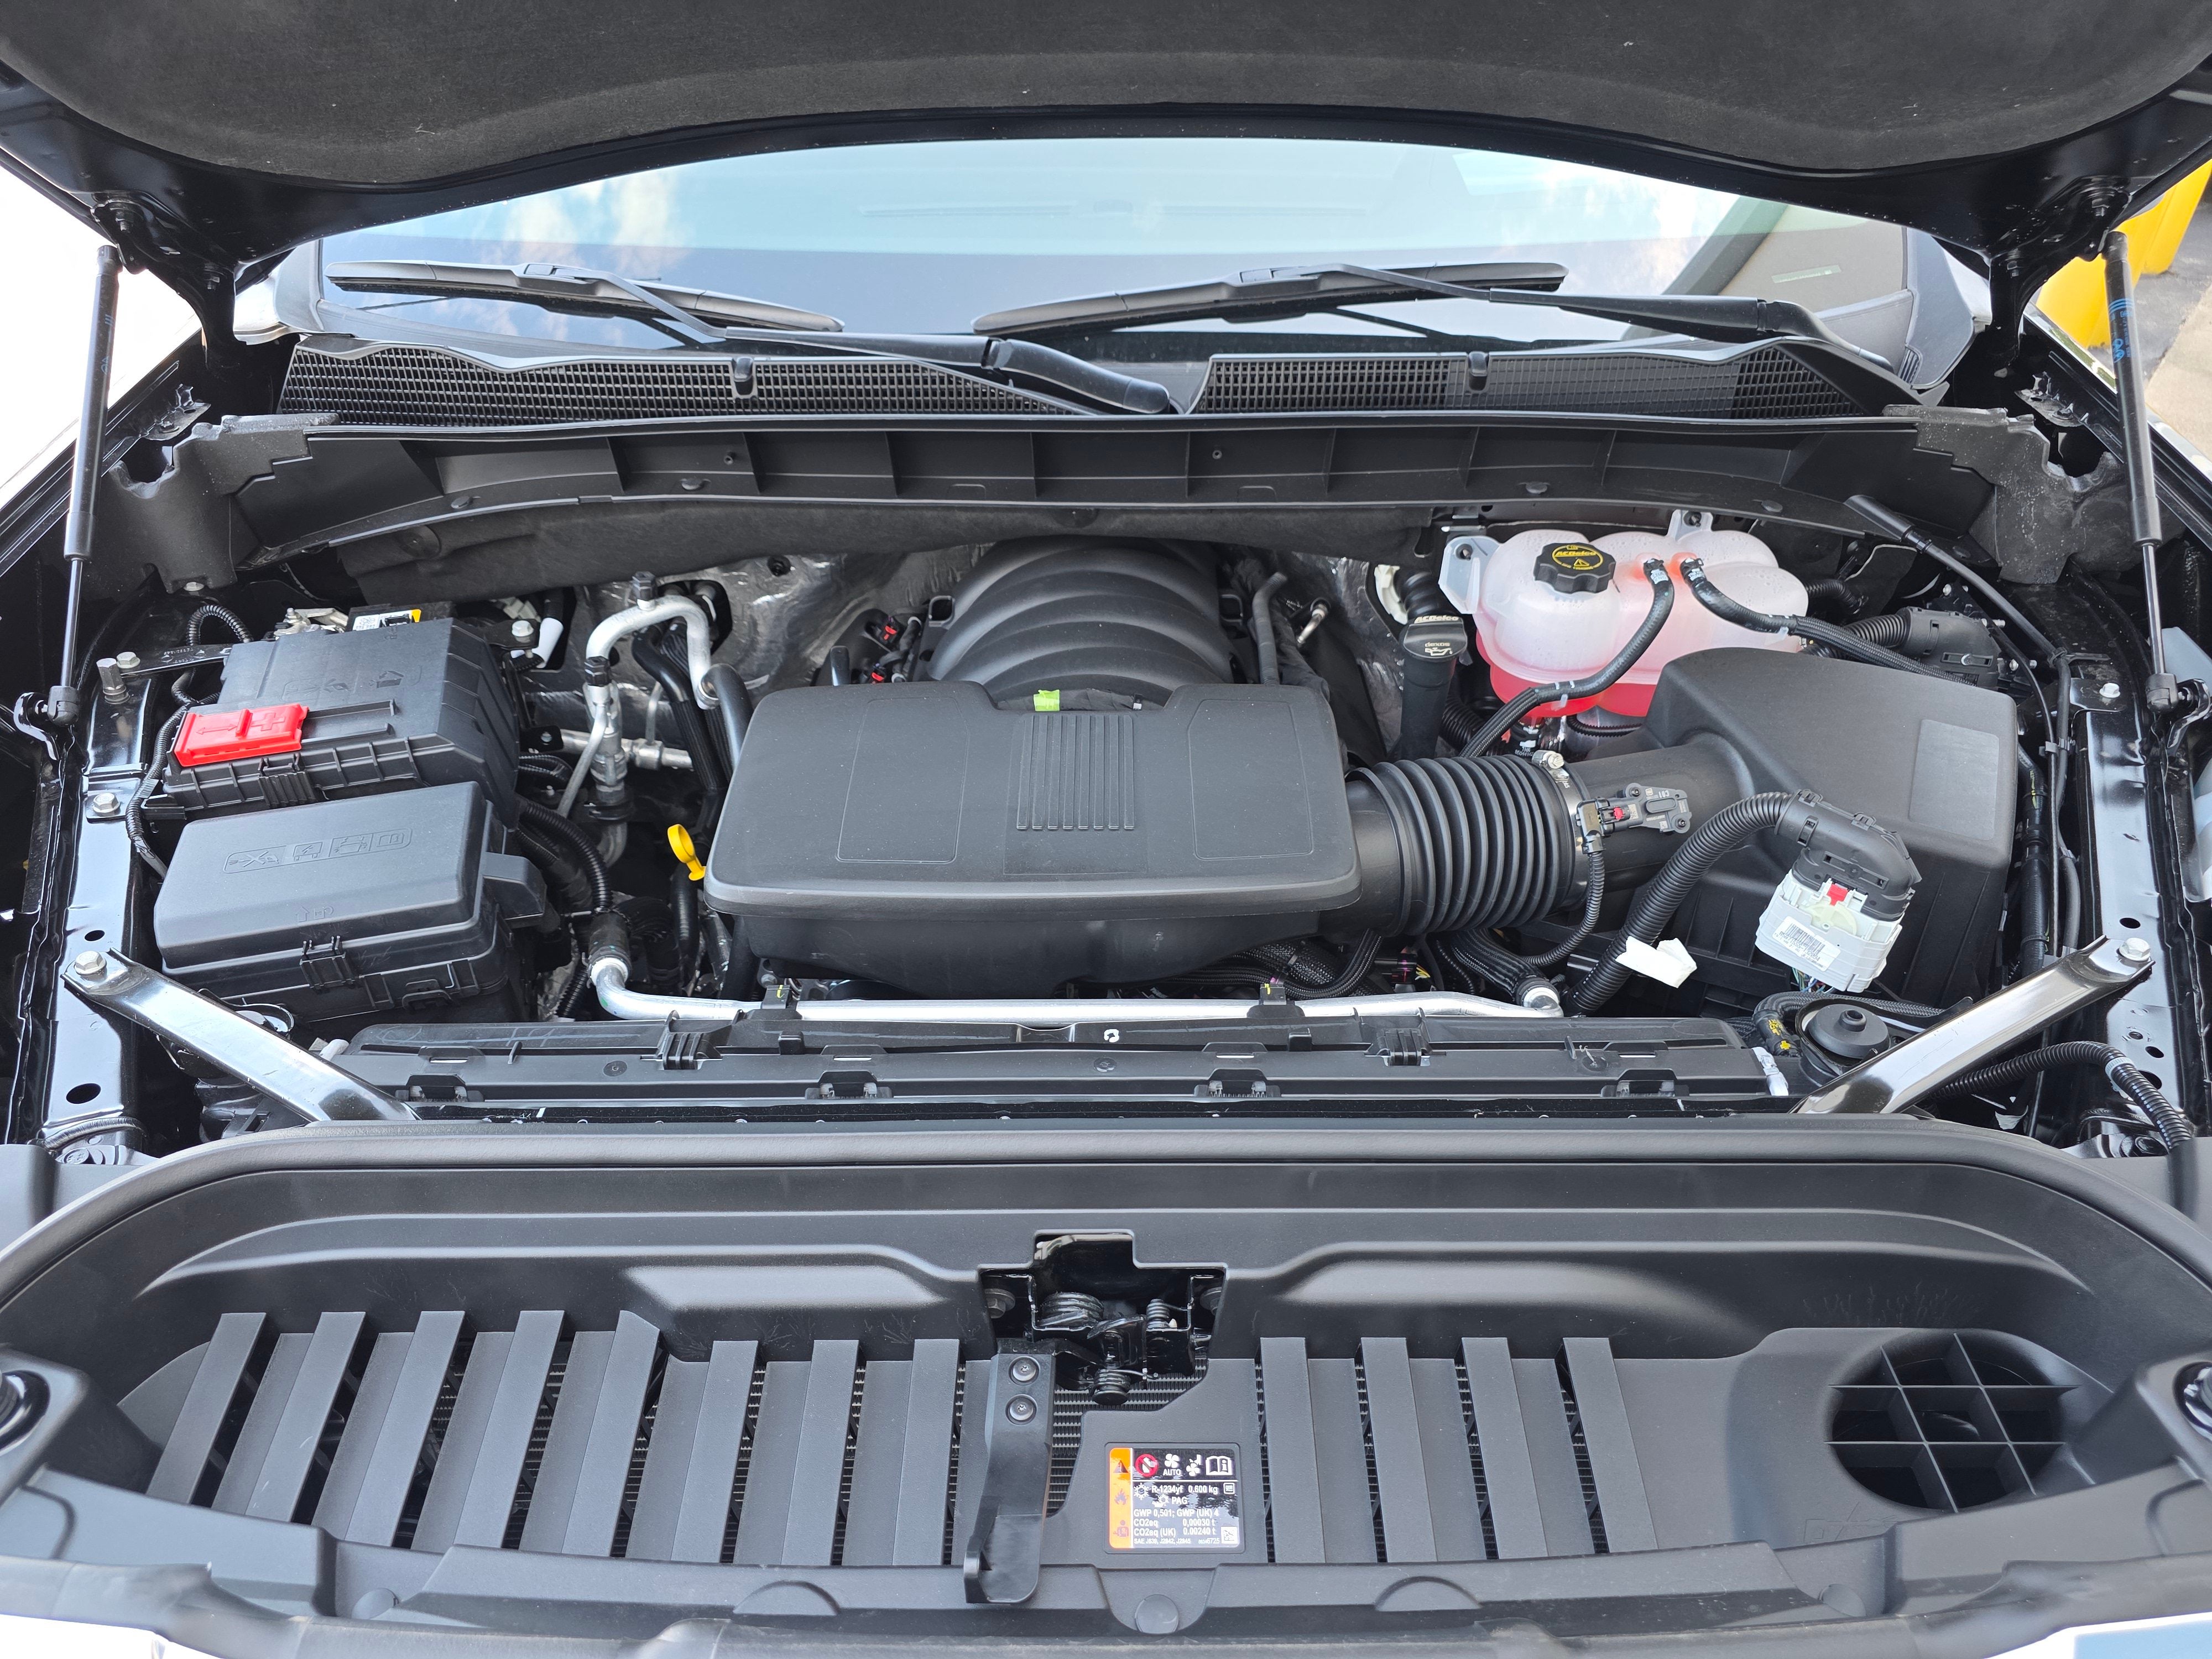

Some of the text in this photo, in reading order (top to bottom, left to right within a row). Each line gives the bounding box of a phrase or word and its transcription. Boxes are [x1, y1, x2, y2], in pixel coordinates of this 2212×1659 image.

[1151, 1485, 1183, 1494] R-1234yf
[1209, 1485, 1218, 1494] kg
[1153, 1509, 1175, 1517] 0,501;
[1196, 1509, 1213, 1517] (UK)
[1134, 1519, 1159, 1527] CO2eq
[1134, 1528, 1159, 1537] CO2eq
[1160, 1528, 1176, 1537] (UK)
